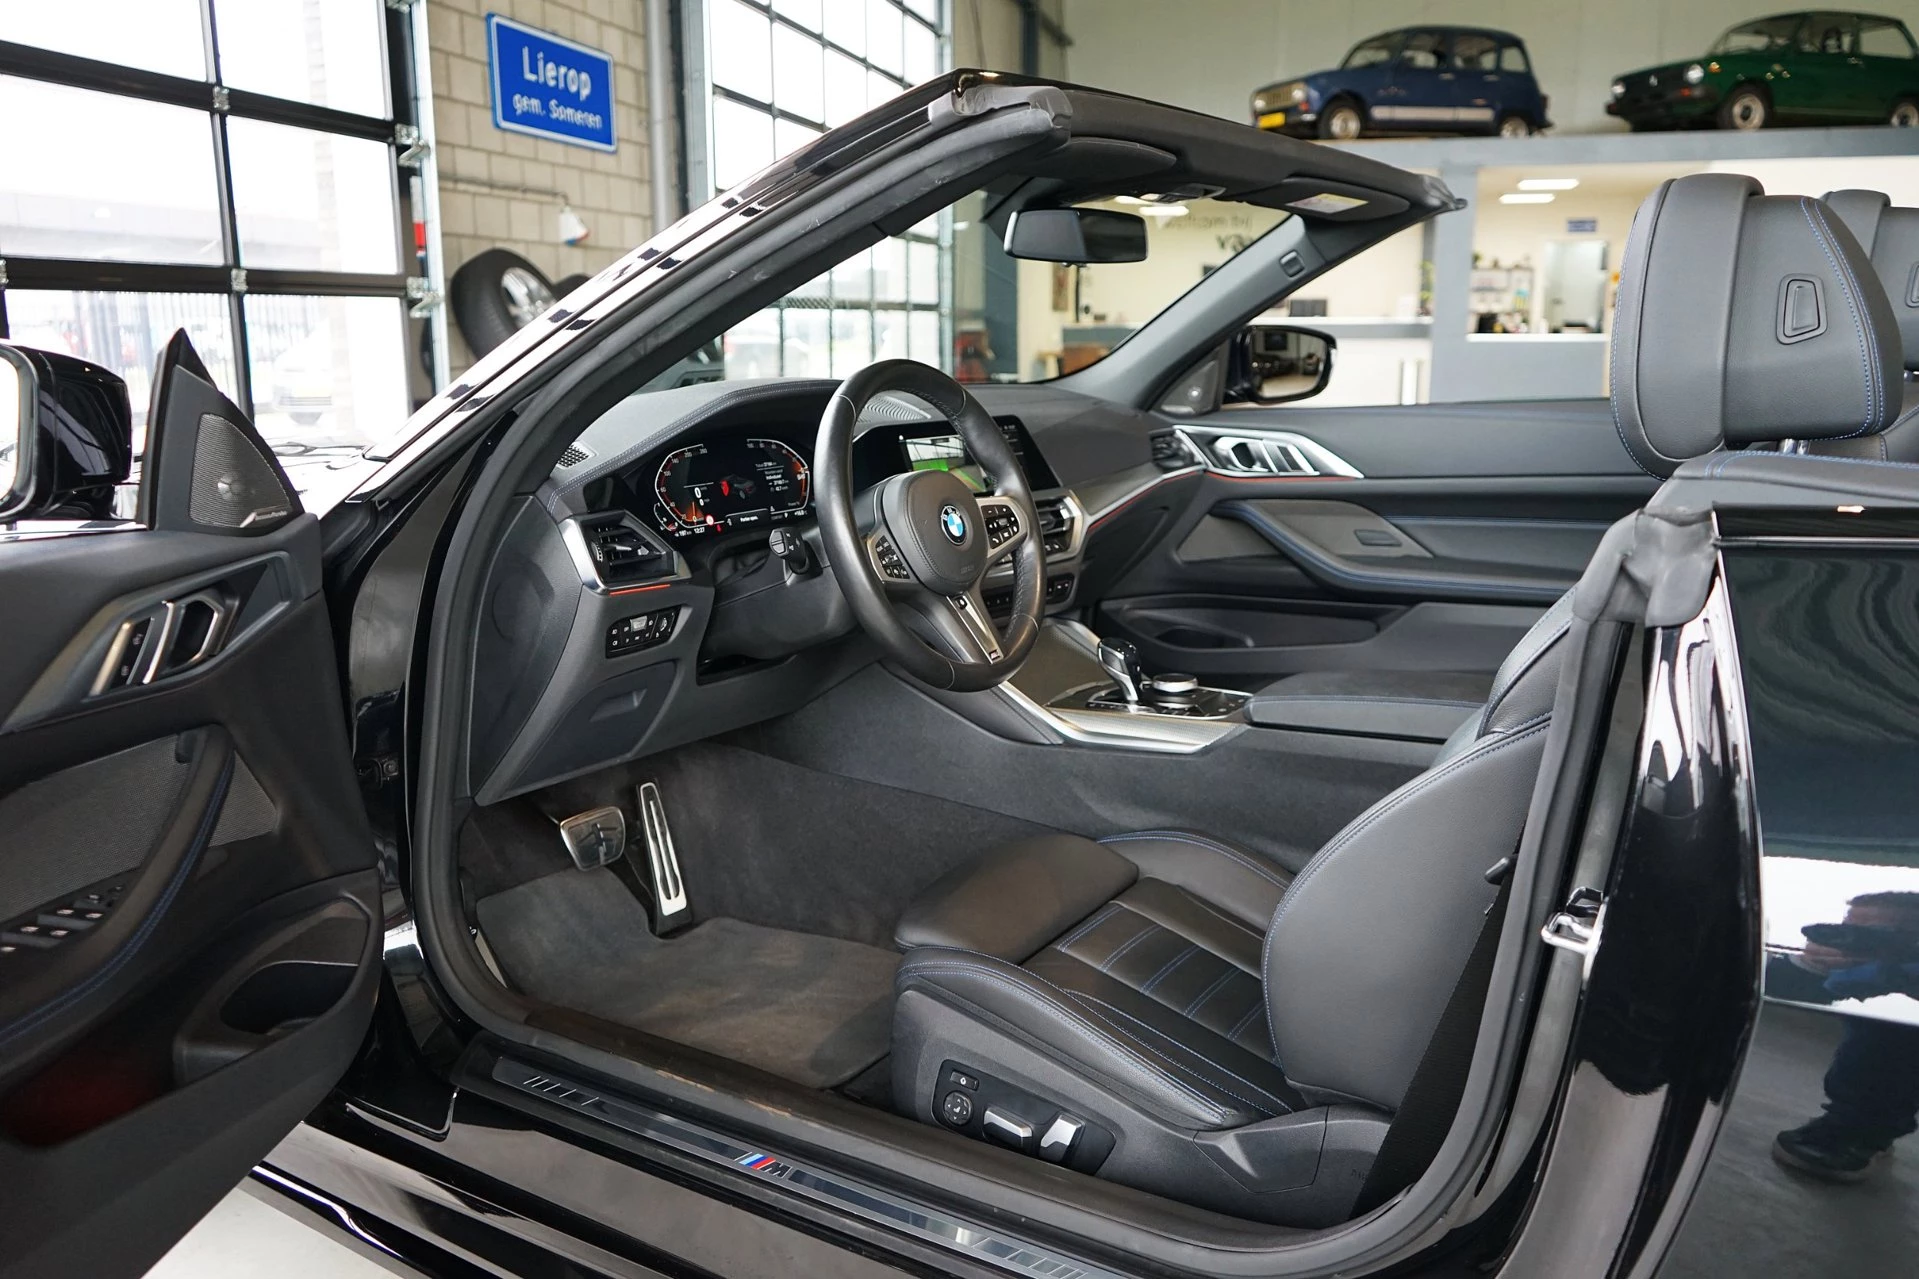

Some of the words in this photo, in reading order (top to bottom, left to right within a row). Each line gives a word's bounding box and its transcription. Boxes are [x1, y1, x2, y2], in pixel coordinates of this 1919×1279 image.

[522, 46, 592, 101] Lierop
[513, 93, 546, 116] gem.
[549, 99, 603, 130] Someren
